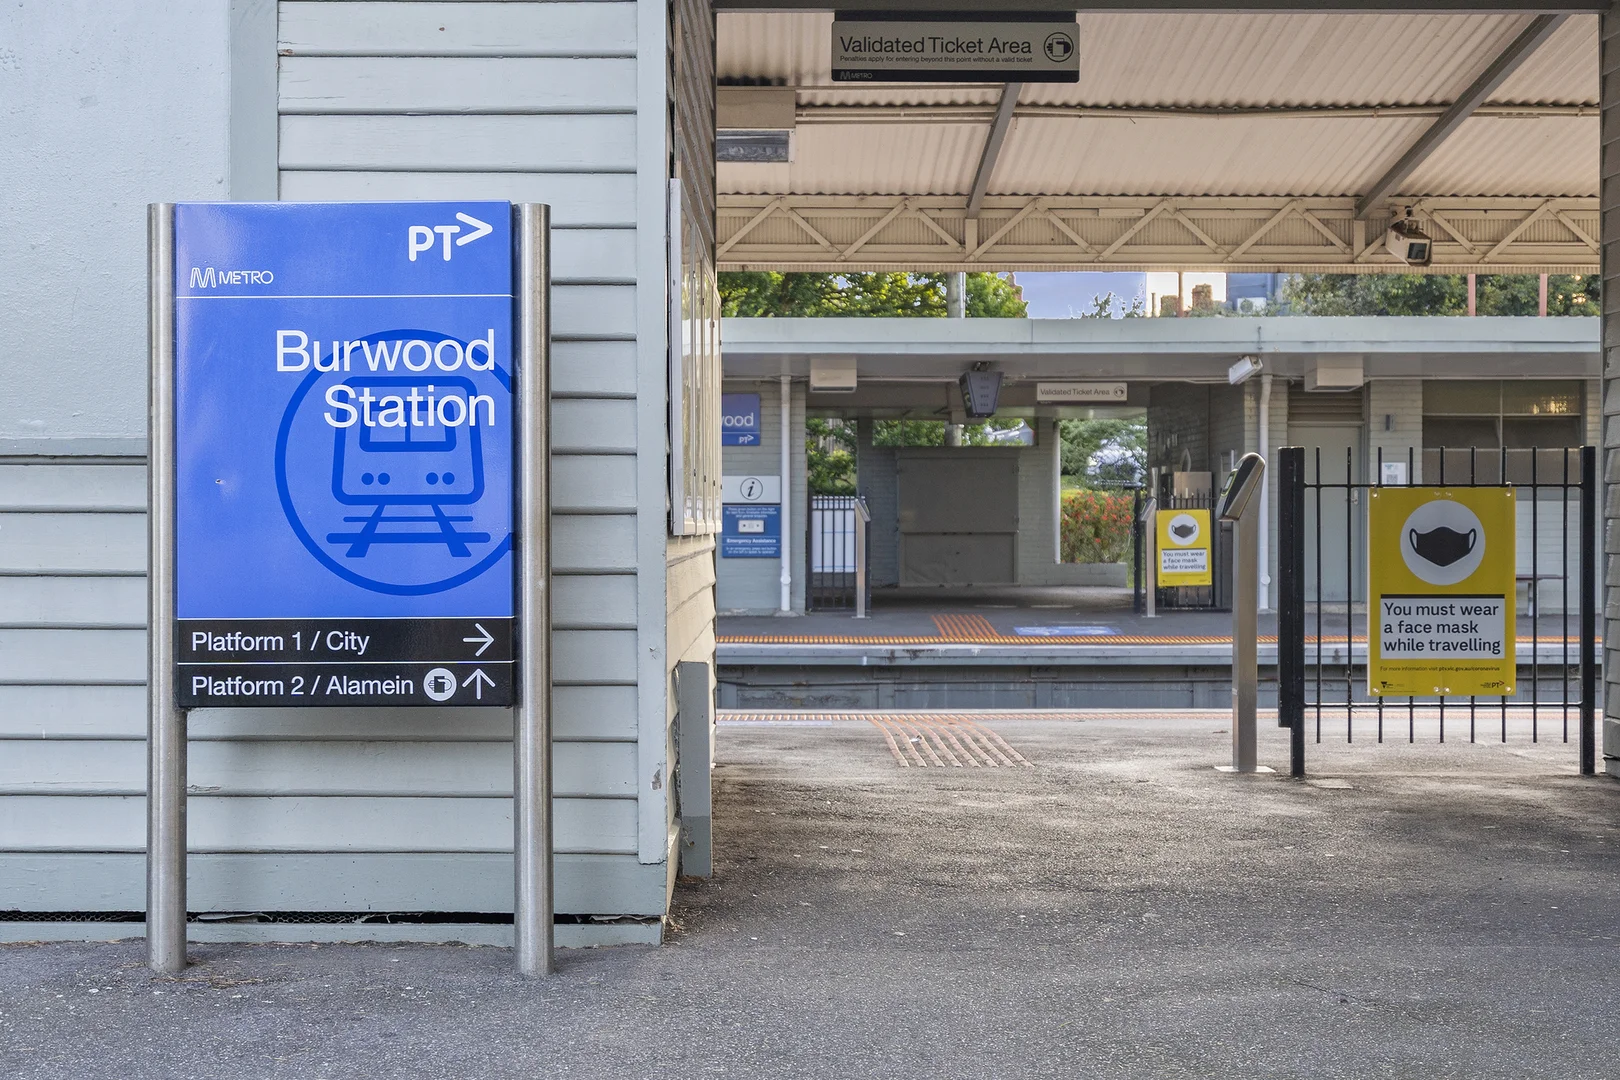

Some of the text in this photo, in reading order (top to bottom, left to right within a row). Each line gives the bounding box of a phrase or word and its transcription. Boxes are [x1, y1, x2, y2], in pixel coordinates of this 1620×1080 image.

[840, 36, 1032, 53] Validated Ticket Area
[219, 270, 274, 284] METRO
[276, 328, 495, 372] Burwood
[324, 384, 495, 428] Station
[722, 412, 754, 427] ood
[1384, 602, 1499, 616] You must wear
[1384, 621, 1478, 634] a face mask
[192, 631, 370, 656] Platform 1 / City
[1384, 638, 1501, 655] while travelling
[192, 676, 414, 696] Platform 2 / Alamein
